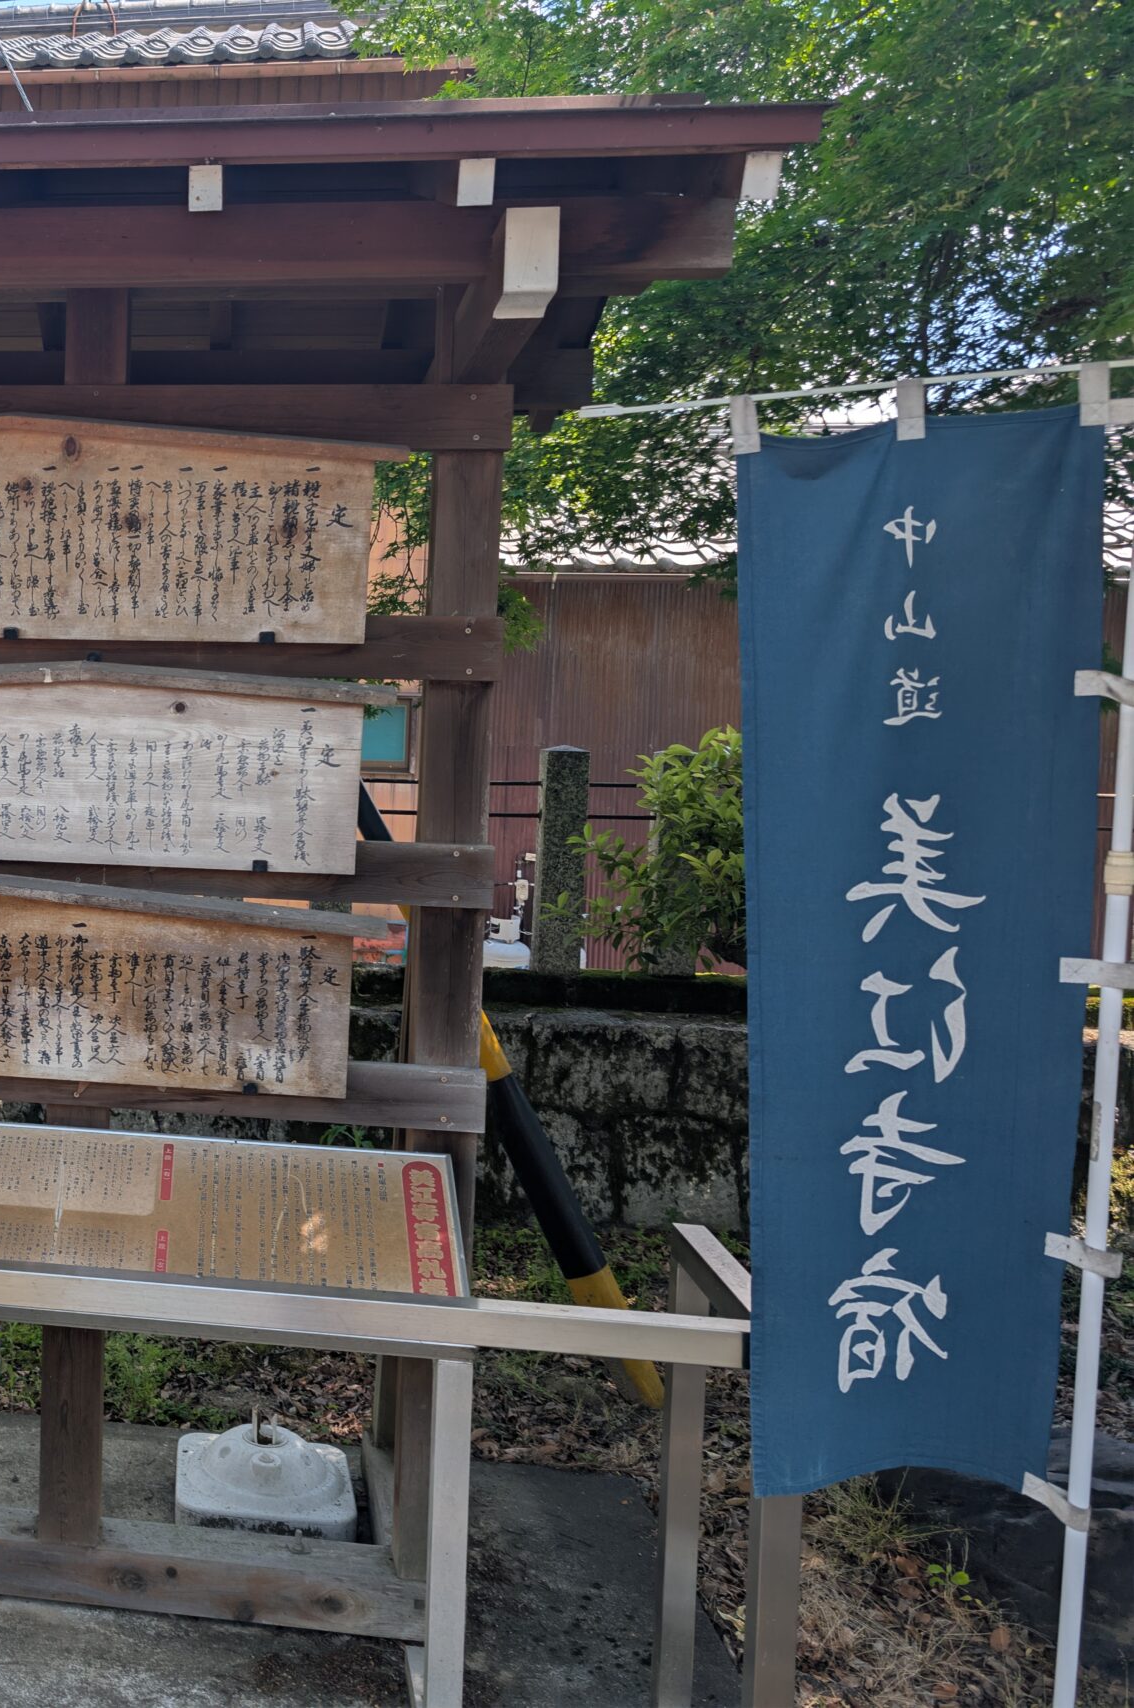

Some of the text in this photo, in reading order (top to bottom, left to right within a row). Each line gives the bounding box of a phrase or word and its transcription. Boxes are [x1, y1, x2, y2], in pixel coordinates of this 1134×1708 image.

[326, 504, 354, 528] 定
[315, 743, 341, 768] 定
[319, 967, 341, 987] 定
